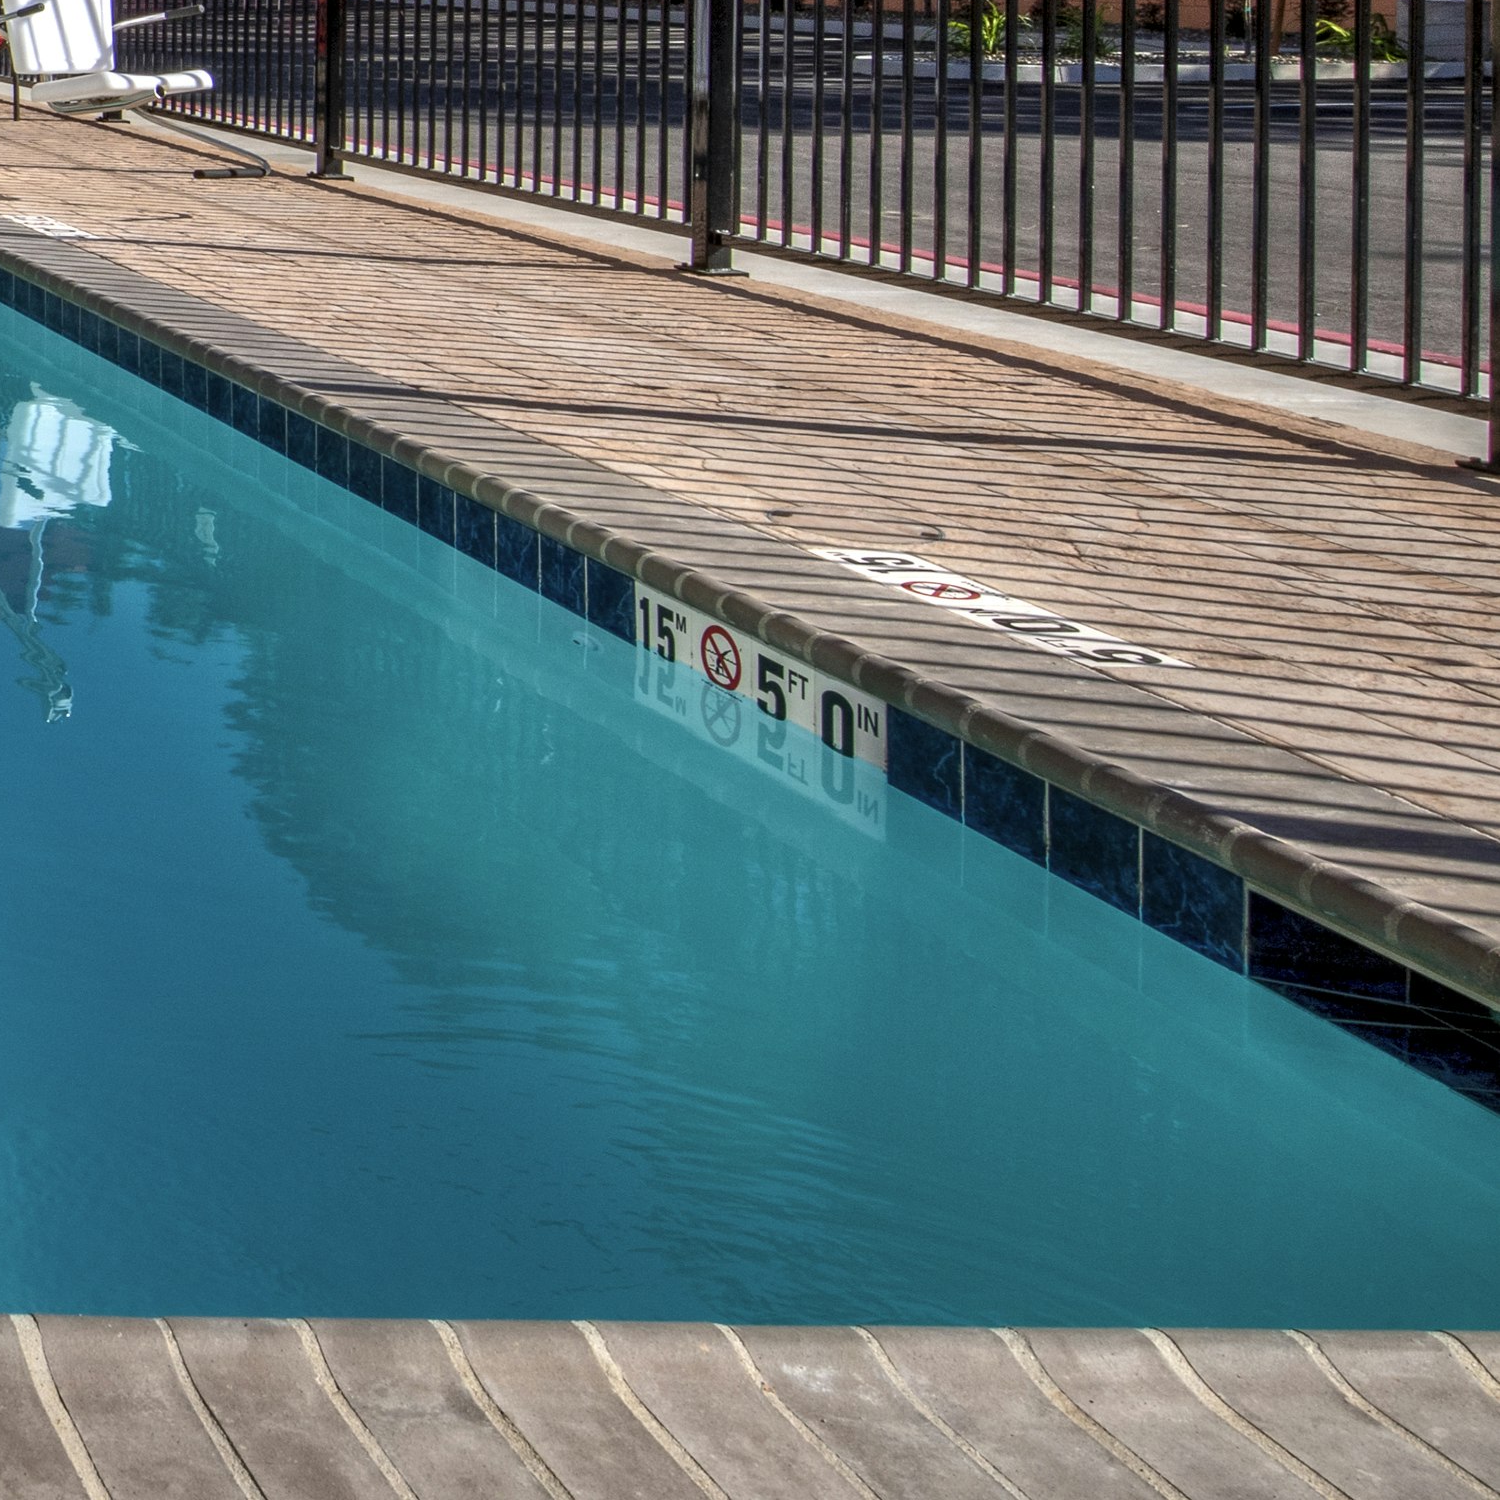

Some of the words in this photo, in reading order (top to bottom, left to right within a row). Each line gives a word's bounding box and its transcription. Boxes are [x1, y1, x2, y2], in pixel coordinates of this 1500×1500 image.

[992, 617, 1080, 633] 0
[1064, 647, 1162, 666] 5
[676, 613, 687, 634] M
[757, 653, 787, 721] 5
[788, 669, 808, 700] FT
[821, 690, 855, 758] 0
[857, 704, 879, 738] IN
